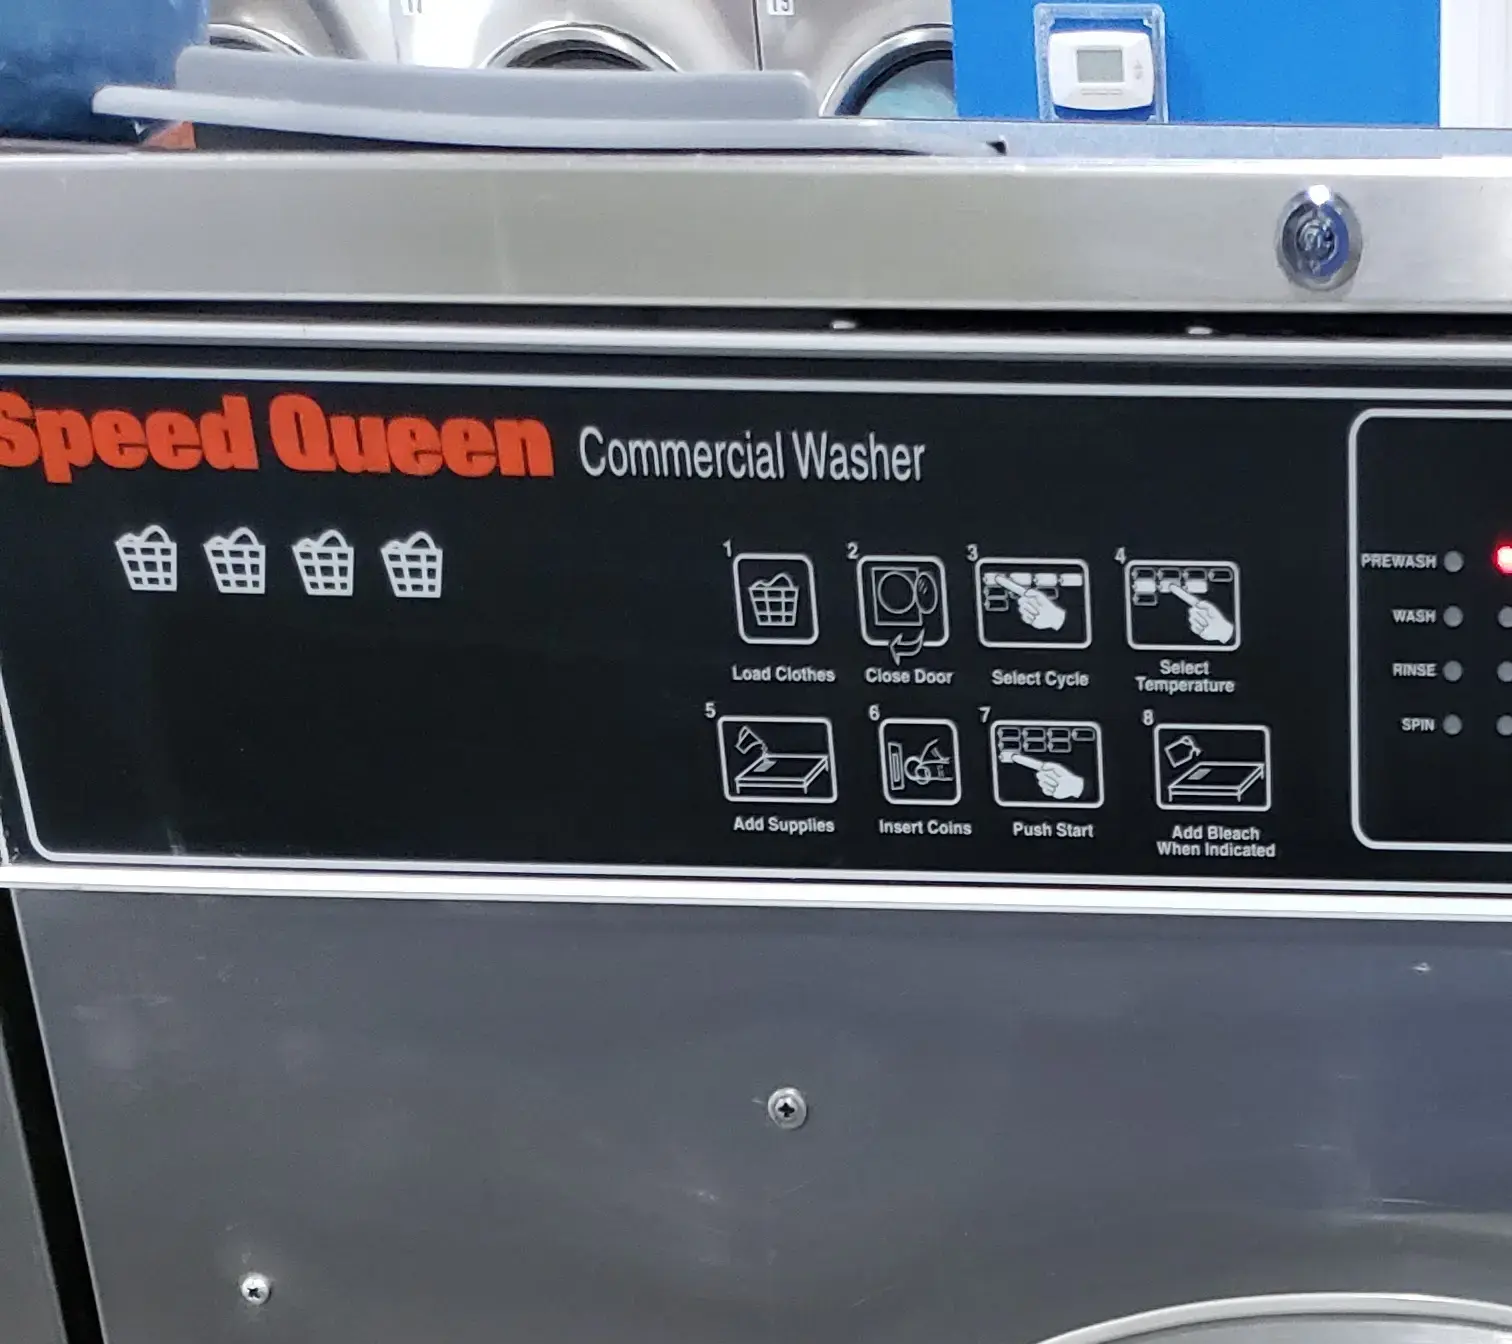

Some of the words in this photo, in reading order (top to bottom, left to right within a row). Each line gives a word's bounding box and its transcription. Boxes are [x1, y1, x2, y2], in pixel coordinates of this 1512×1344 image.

[0, 391, 259, 484] Speed
[269, 393, 555, 478] Queen
[578, 425, 785, 480] Commercial
[791, 430, 925, 482] Washer
[722, 539, 732, 557] 1
[846, 541, 859, 560] 2
[966, 543, 979, 562] 3
[1113, 546, 1127, 565] 4
[1361, 553, 1438, 569] PREWASH
[1392, 609, 1437, 624] WASH
[732, 664, 772, 682] Load
[775, 665, 836, 682] Clothes
[864, 667, 910, 684] Close
[914, 668, 955, 684] Door
[1159, 658, 1210, 676] Select
[1392, 662, 1438, 677] RINSE
[991, 668, 1041, 687] Select
[1045, 670, 1090, 691] Cycle
[1135, 675, 1236, 696] Temperature
[704, 702, 717, 719] 5
[868, 704, 881, 722] 6
[979, 707, 991, 723] 7
[1142, 708, 1155, 726] 8
[1401, 717, 1436, 732] SPIN
[733, 815, 765, 833] Add
[767, 817, 836, 836] Supplies
[879, 819, 924, 836] Insert
[927, 820, 972, 836] Coins
[1013, 821, 1052, 838] Push
[1056, 822, 1095, 839] Start
[1171, 825, 1203, 842] Add
[1207, 826, 1260, 843] Bleach
[1157, 842, 1201, 857] When
[1204, 842, 1276, 859] Indicated
